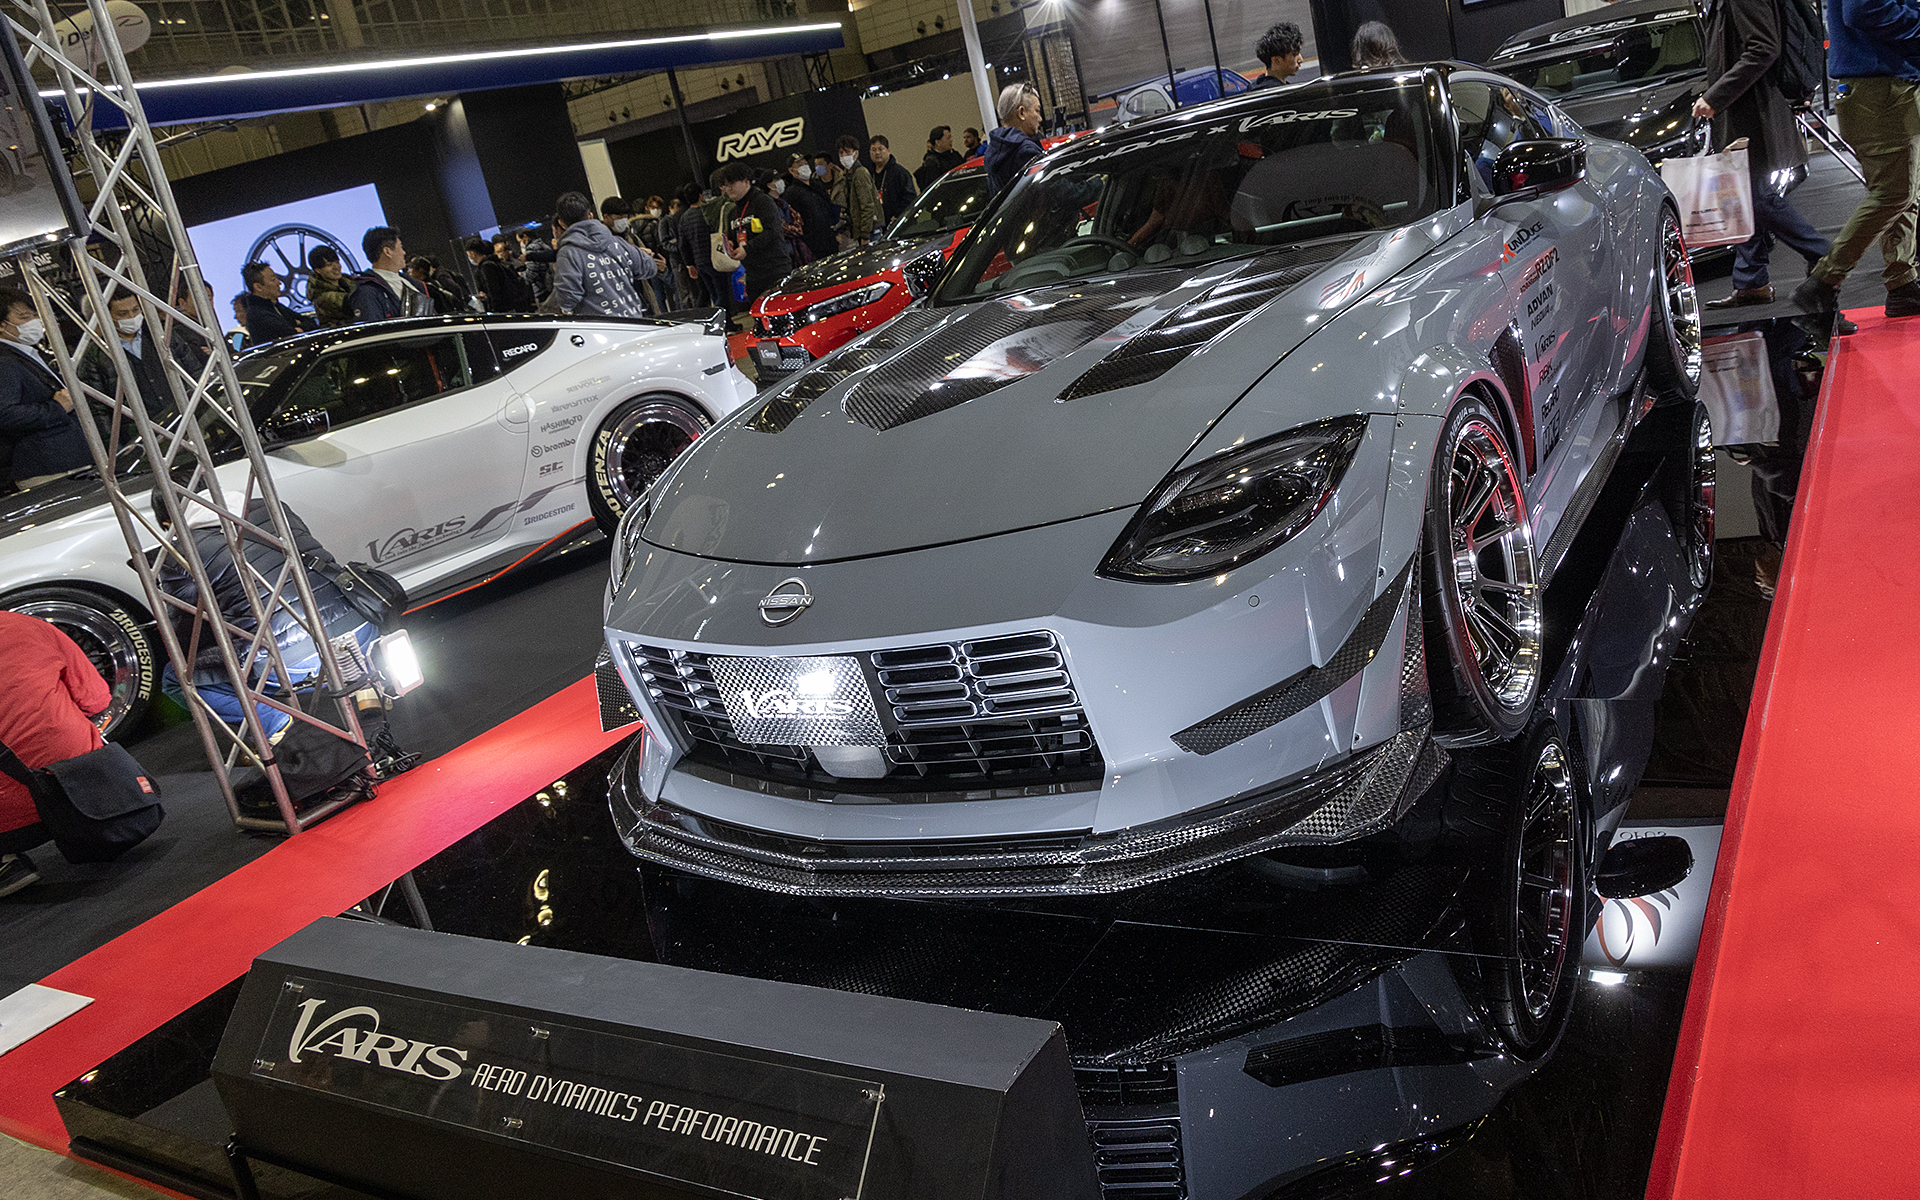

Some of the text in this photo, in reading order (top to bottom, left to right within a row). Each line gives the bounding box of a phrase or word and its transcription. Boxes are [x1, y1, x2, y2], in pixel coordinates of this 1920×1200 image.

[1238, 108, 1359, 133] VARIS
[717, 117, 804, 162] RAYS
[1527, 284, 1554, 317] ADVAN
[502, 343, 538, 357] RECARO
[540, 415, 583, 433] HASHIMOTO
[543, 438, 576, 452] brembo
[524, 503, 575, 526] BRIDGESTONE
[365, 516, 466, 563] VARIS
[758, 597, 812, 607] NISSAN
[109, 608, 152, 701] BRIDGESTONE
[289, 998, 828, 1166] VARIS AERO DYNAMICS PERFORMANCE
